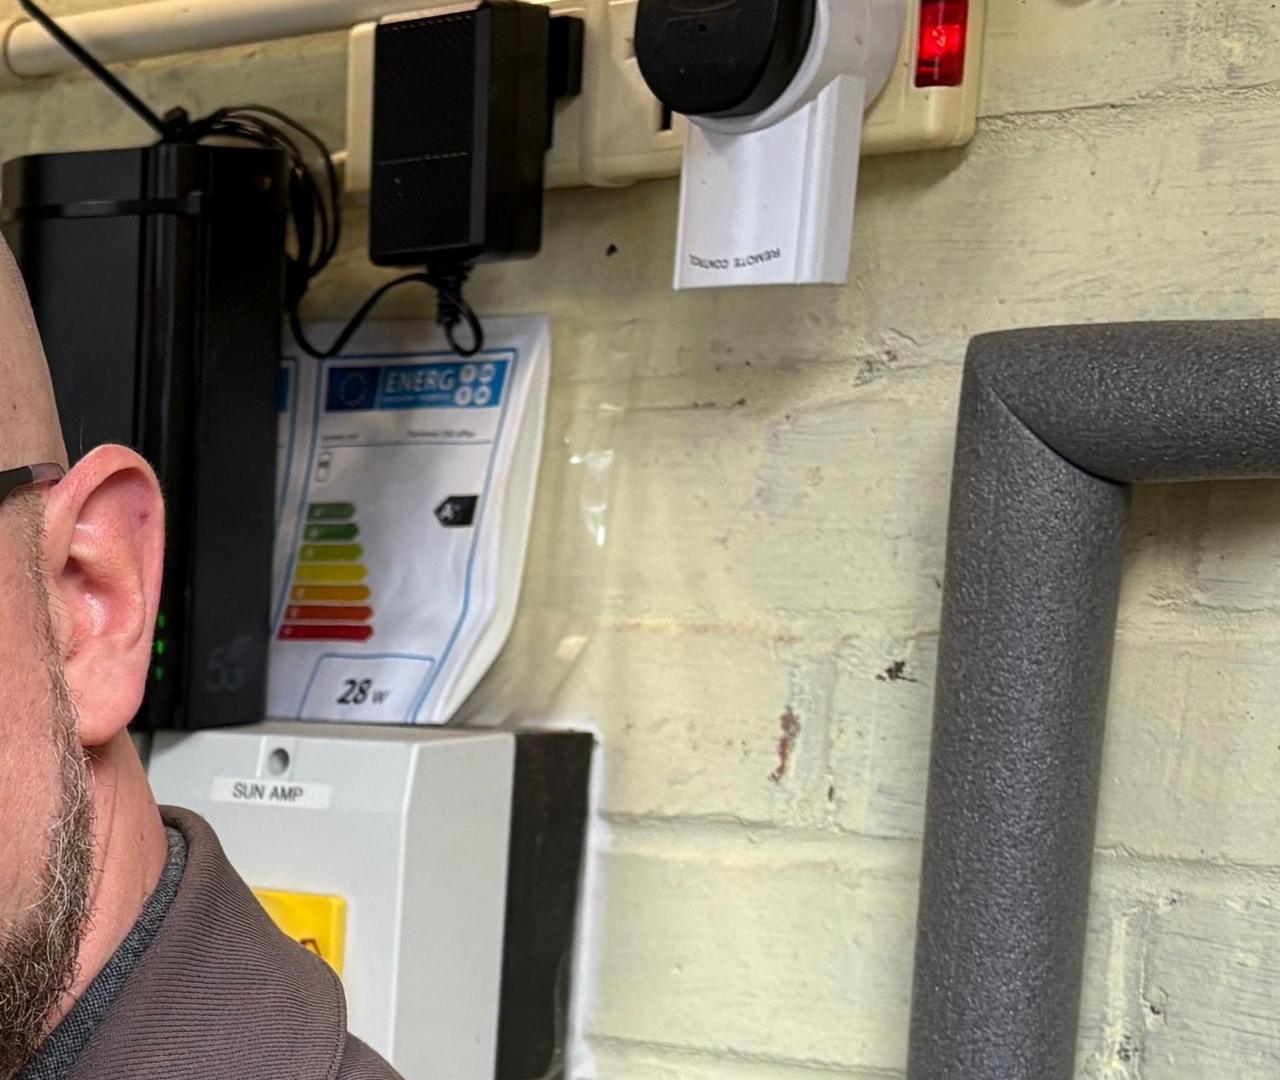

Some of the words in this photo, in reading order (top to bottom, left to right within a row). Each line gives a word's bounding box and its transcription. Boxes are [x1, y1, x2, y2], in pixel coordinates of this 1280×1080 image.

[734, 248, 781, 268] REMOTE
[385, 368, 456, 393] ENERG
[336, 678, 373, 705] 28
[232, 781, 266, 800] SUN
[269, 784, 304, 802] AMP
